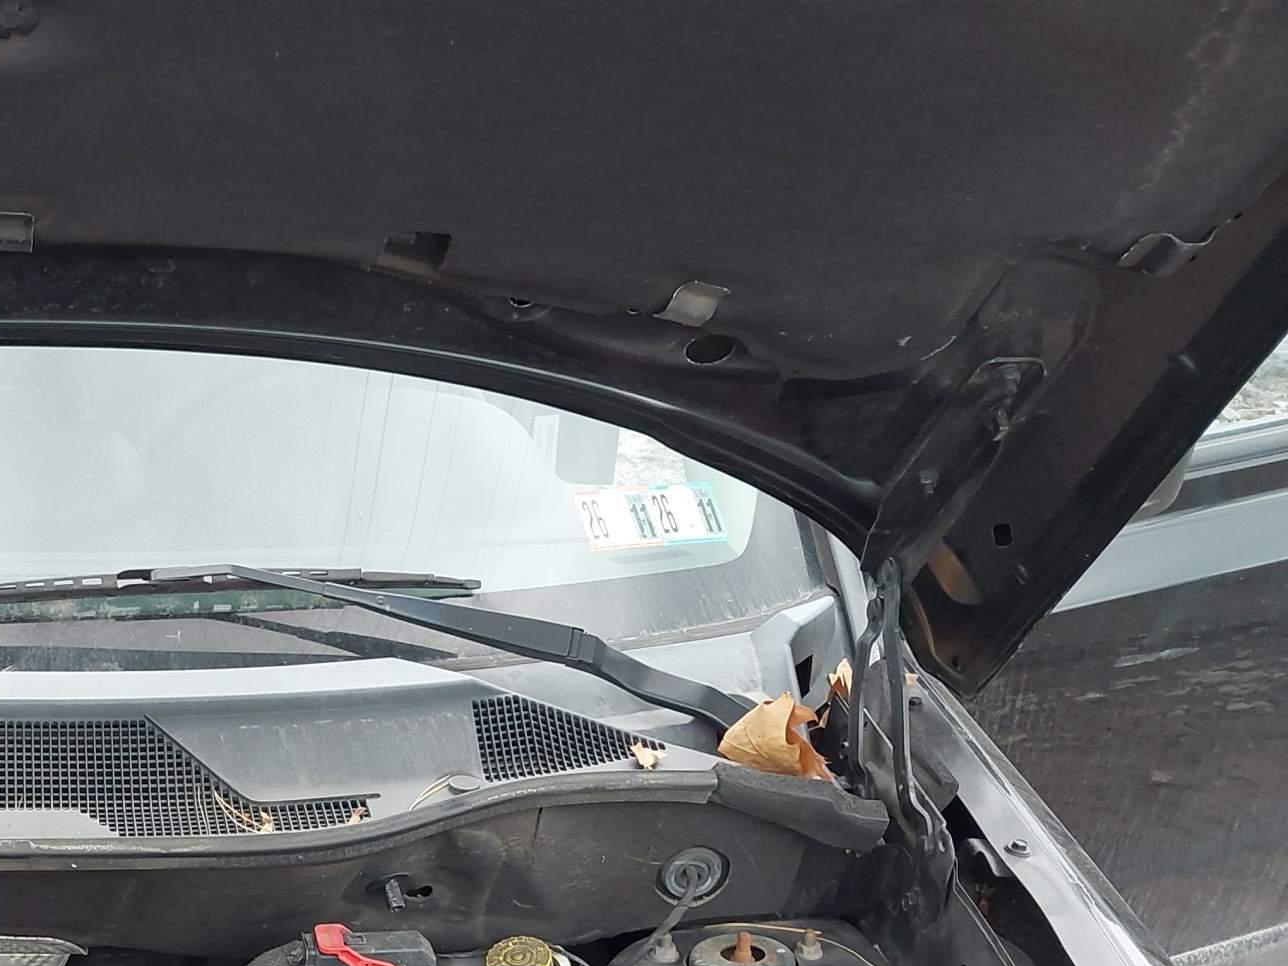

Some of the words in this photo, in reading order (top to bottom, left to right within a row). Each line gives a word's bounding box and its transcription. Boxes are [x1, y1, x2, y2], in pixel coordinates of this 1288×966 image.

[582, 500, 609, 539] 26
[630, 504, 657, 538] 11
[652, 493, 679, 534] 26
[697, 497, 722, 533] 11
